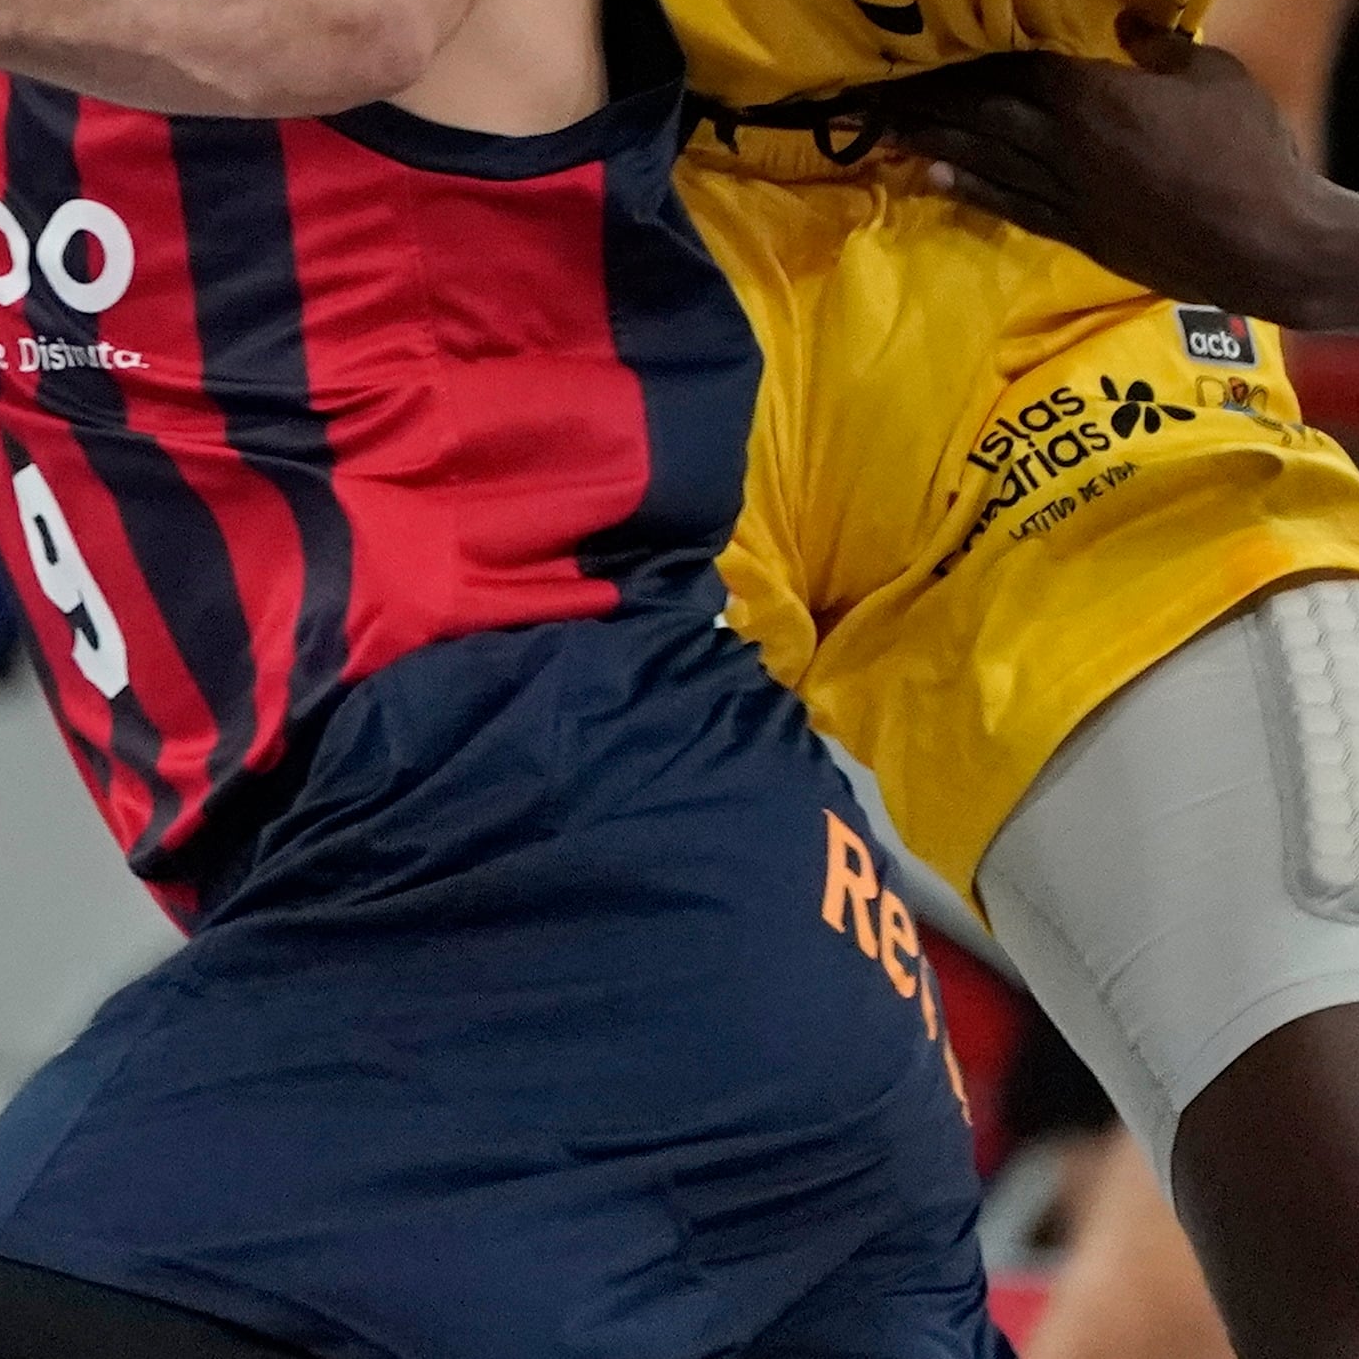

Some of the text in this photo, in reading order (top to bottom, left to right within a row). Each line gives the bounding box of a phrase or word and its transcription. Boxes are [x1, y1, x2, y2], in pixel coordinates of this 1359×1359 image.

[1190, 330, 1241, 359] acb
[967, 386, 1085, 474] Islas
[1078, 476, 1103, 503] DE
[12, 463, 129, 699] 9
